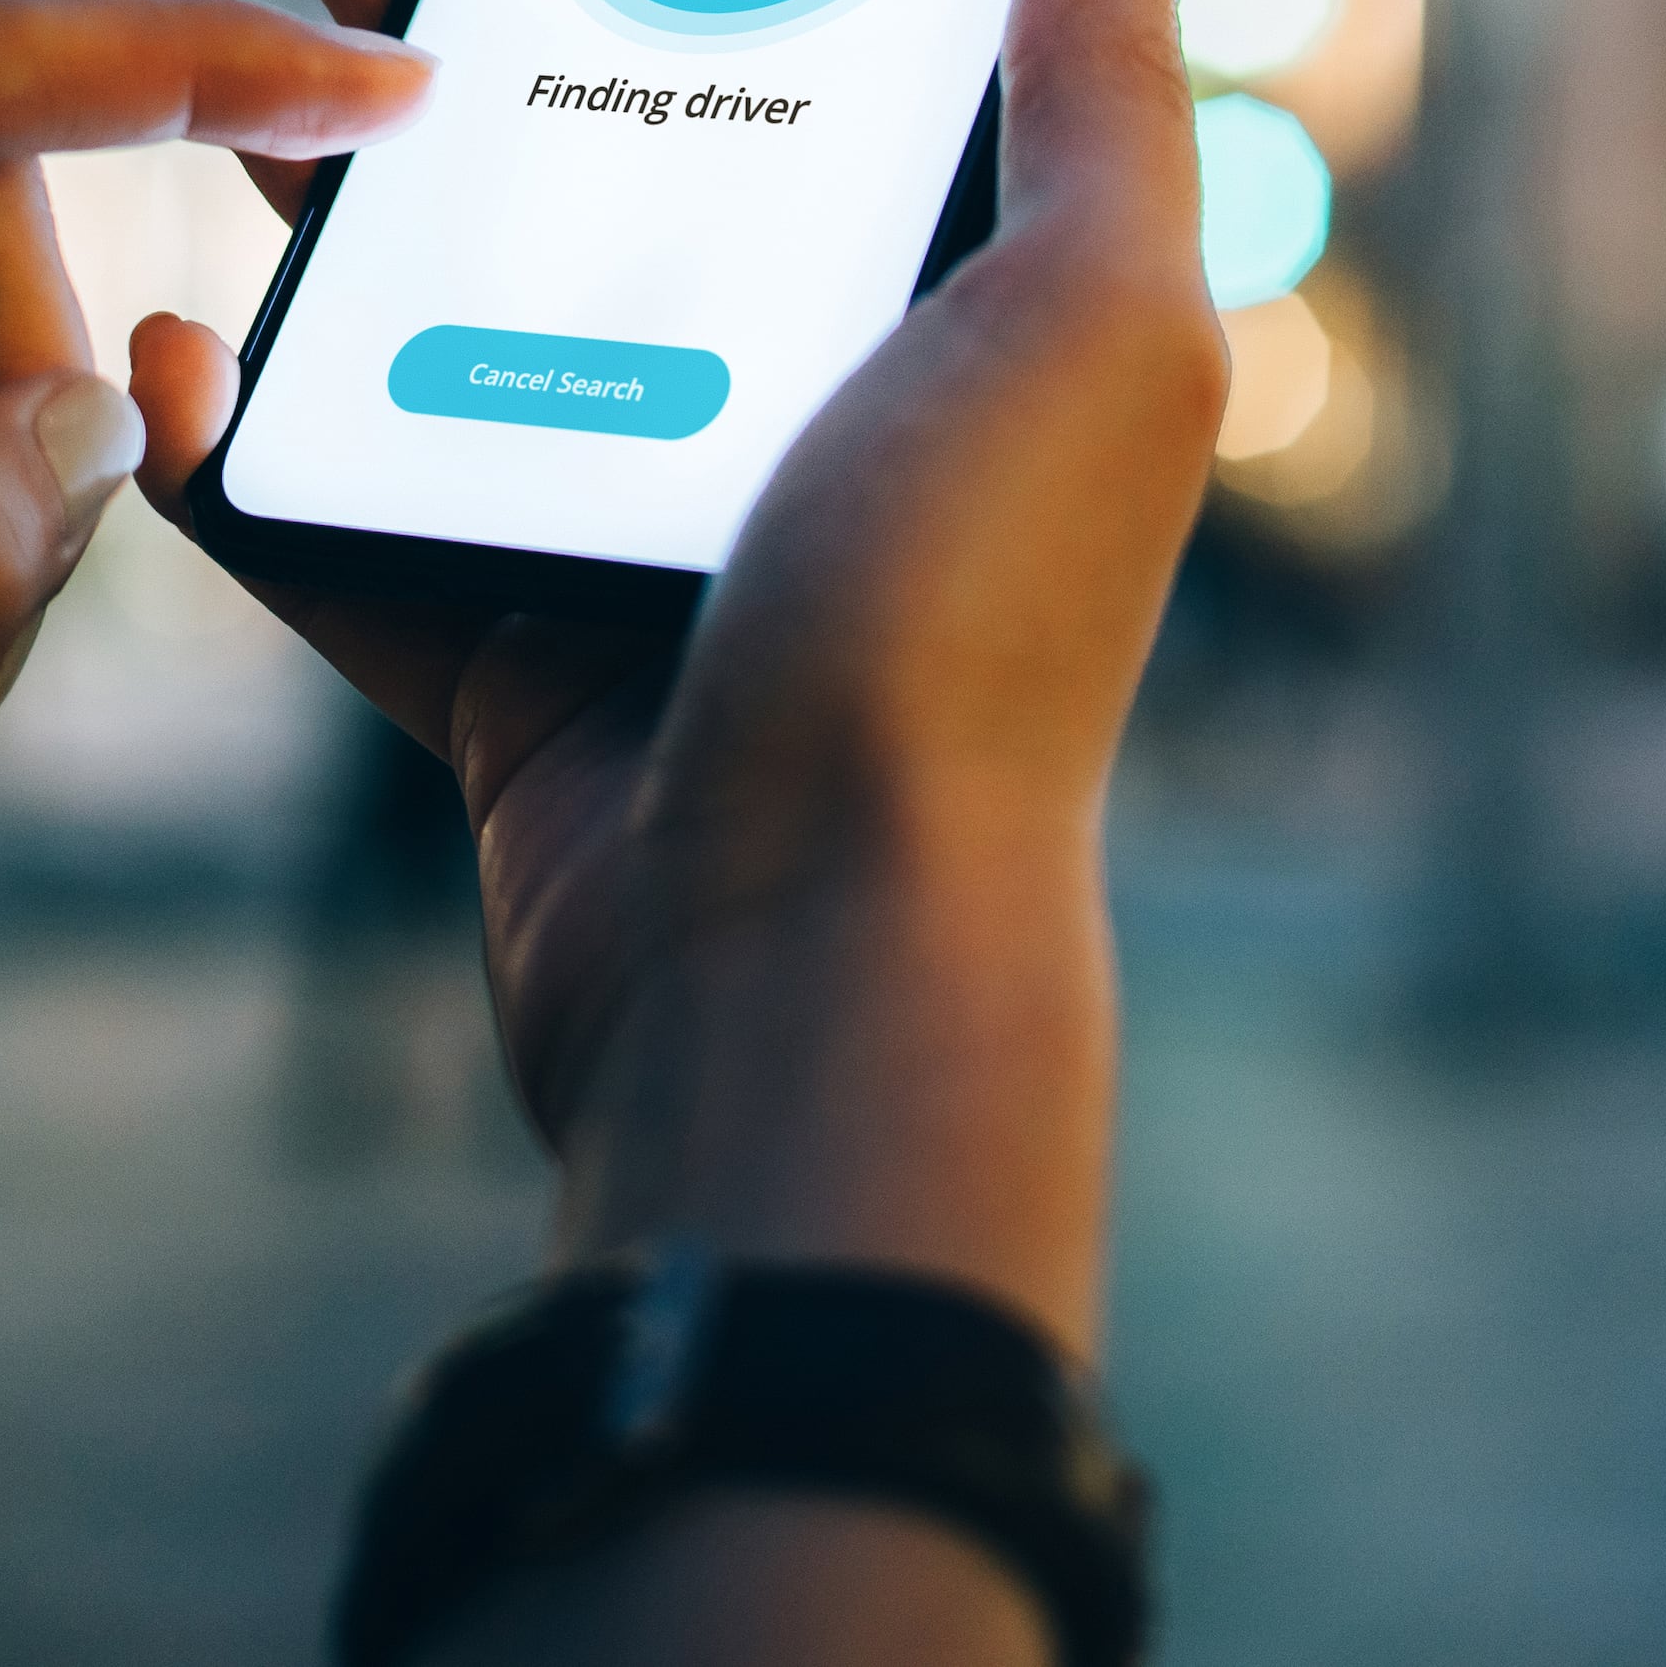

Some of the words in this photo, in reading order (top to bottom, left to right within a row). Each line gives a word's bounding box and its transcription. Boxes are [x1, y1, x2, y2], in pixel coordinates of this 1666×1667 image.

[526, 74, 678, 126] Finding
[685, 84, 812, 126] driver
[469, 363, 554, 393] Cancel
[556, 372, 644, 402] Search
